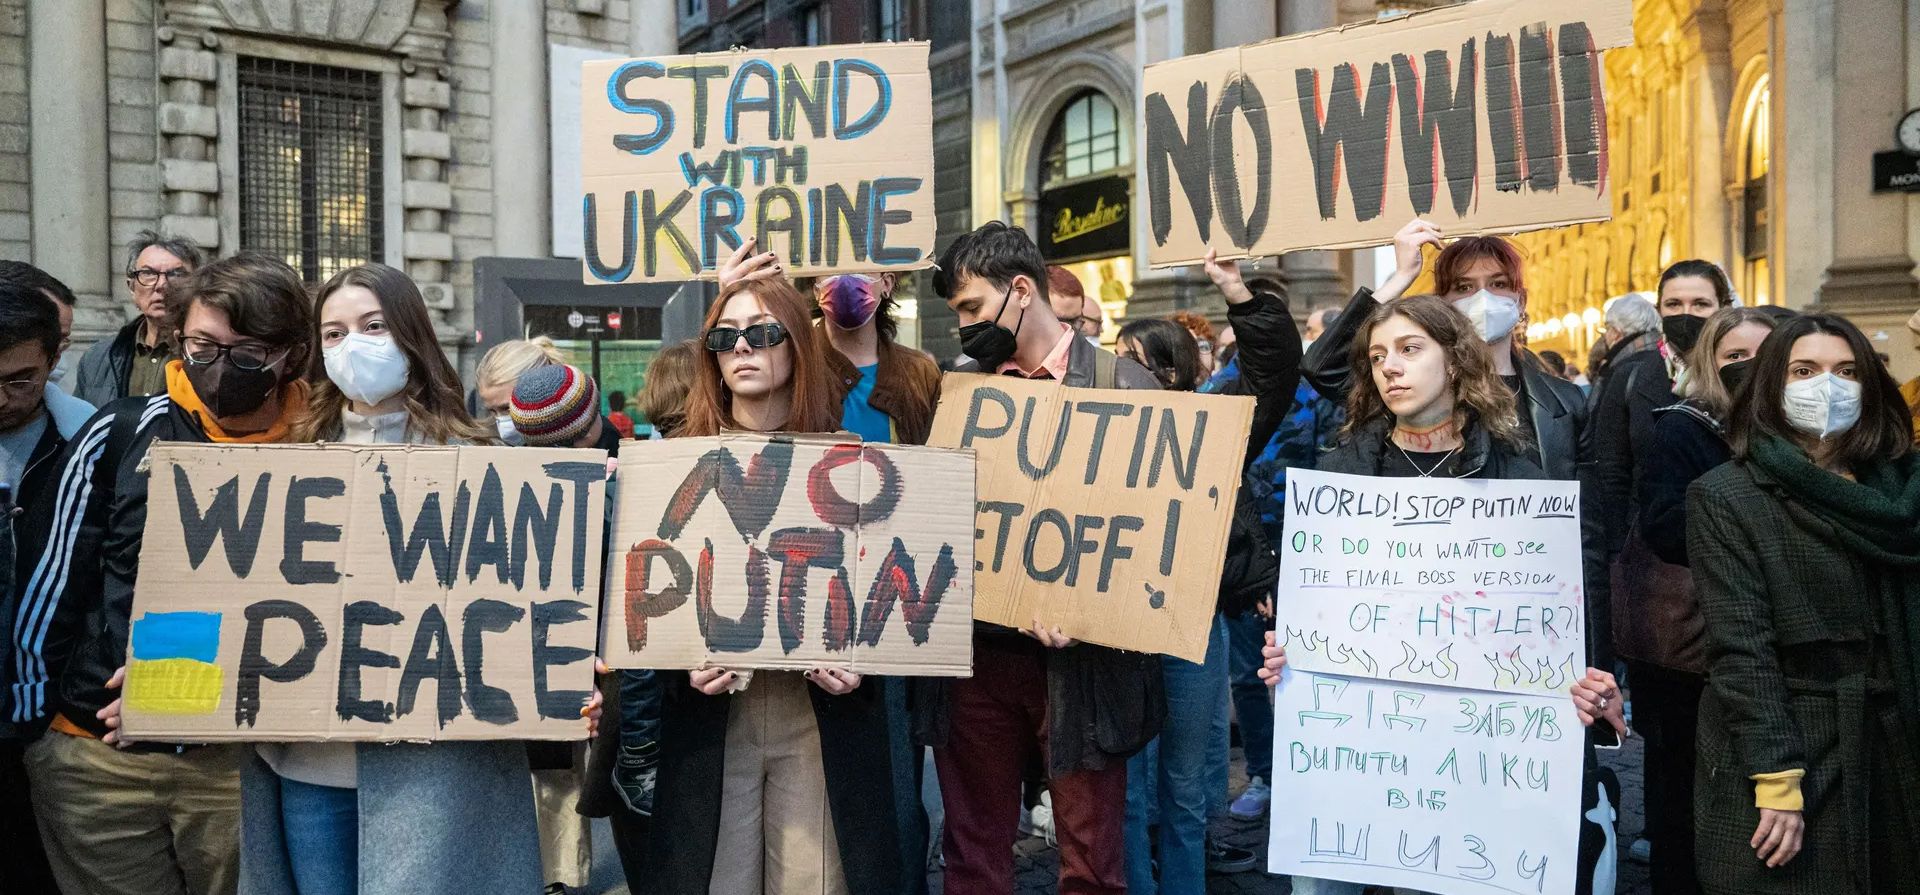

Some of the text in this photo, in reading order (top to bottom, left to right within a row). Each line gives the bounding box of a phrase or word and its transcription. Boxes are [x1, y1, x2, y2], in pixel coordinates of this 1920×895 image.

[607, 58, 892, 155] STAND
[1145, 22, 1609, 249] NO WWIII
[679, 146, 808, 189] WITH
[583, 177, 923, 282] UKRAINE
[656, 438, 904, 544] NO
[960, 386, 1219, 511] PUTIN,
[1293, 480, 1576, 521] WORLD! STOP PUTIN NOW
[174, 458, 606, 595] WE WANT
[1292, 531, 1323, 554] OR
[1342, 538, 1369, 554] DO
[1386, 540, 1422, 558] YOU
[1300, 568, 1556, 587] THE FINAL BOSS VERSION
[625, 527, 958, 655] PUTIN
[1349, 602, 1390, 634] OF
[236, 599, 596, 730] PEACE
